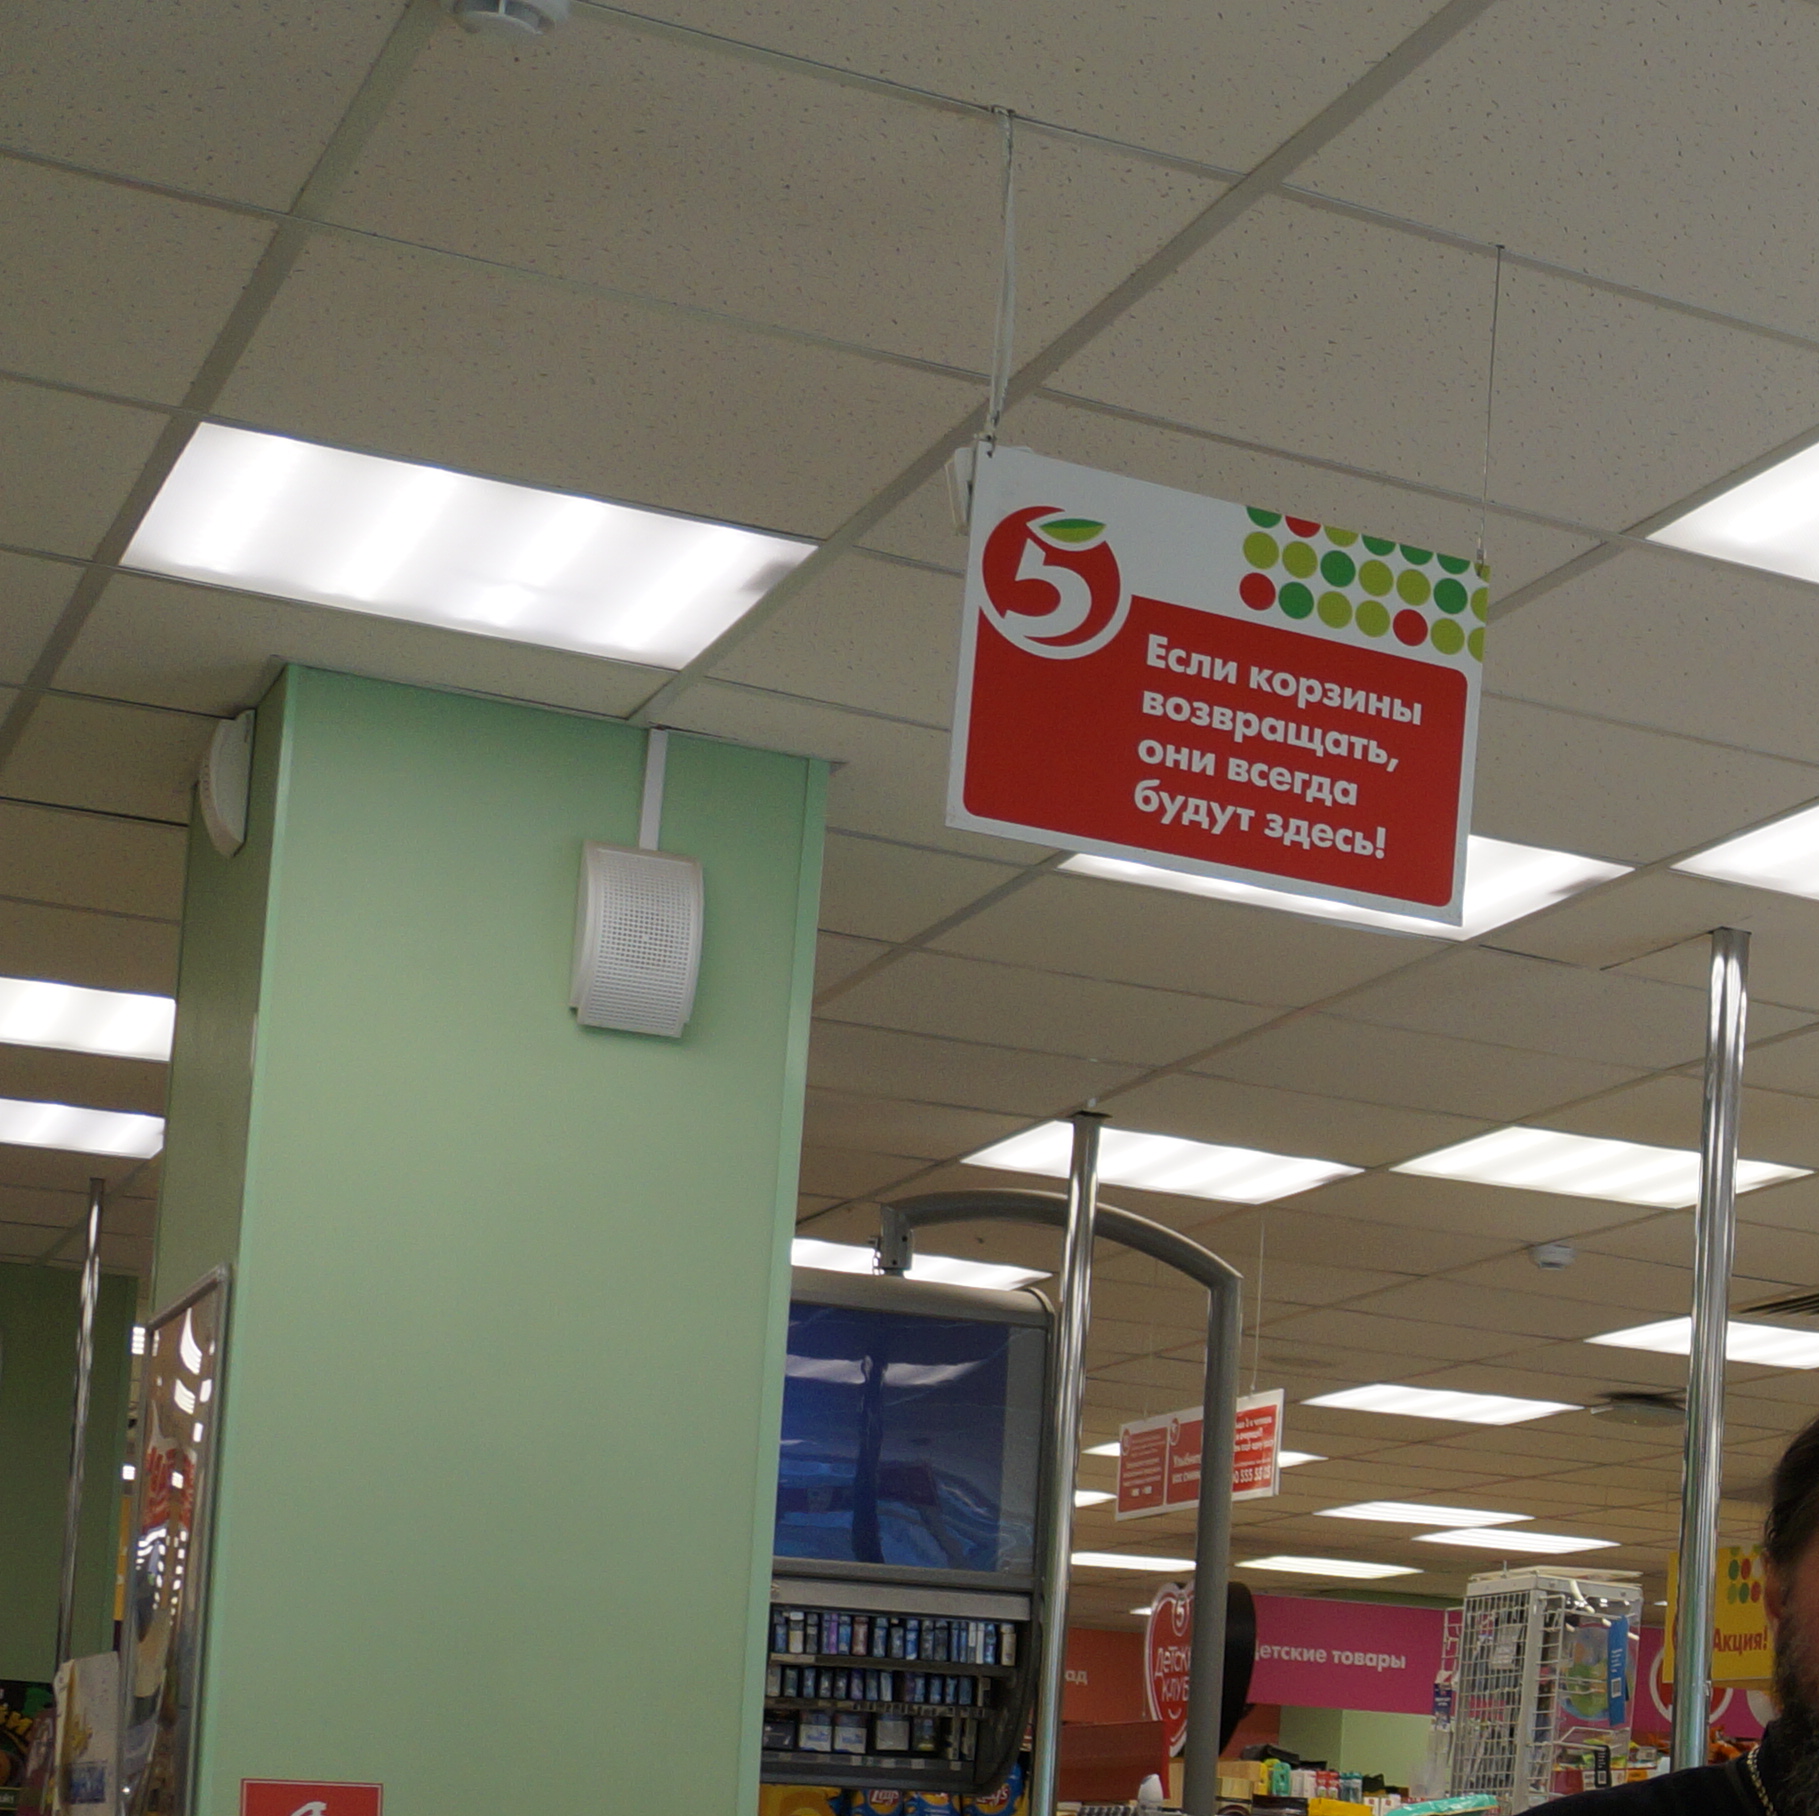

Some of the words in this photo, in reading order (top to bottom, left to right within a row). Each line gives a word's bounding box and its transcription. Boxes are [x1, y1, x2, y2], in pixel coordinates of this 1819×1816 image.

[1146, 634, 1238, 686] Если
[1249, 663, 1423, 727] корзины
[1137, 737, 1217, 777] они
[1227, 762, 1358, 807] всегда
[1141, 690, 1400, 772] возвращать,
[1133, 778, 1255, 832] будут
[1264, 810, 1387, 860] здесь!
[1332, 1649, 1407, 1673] товары
